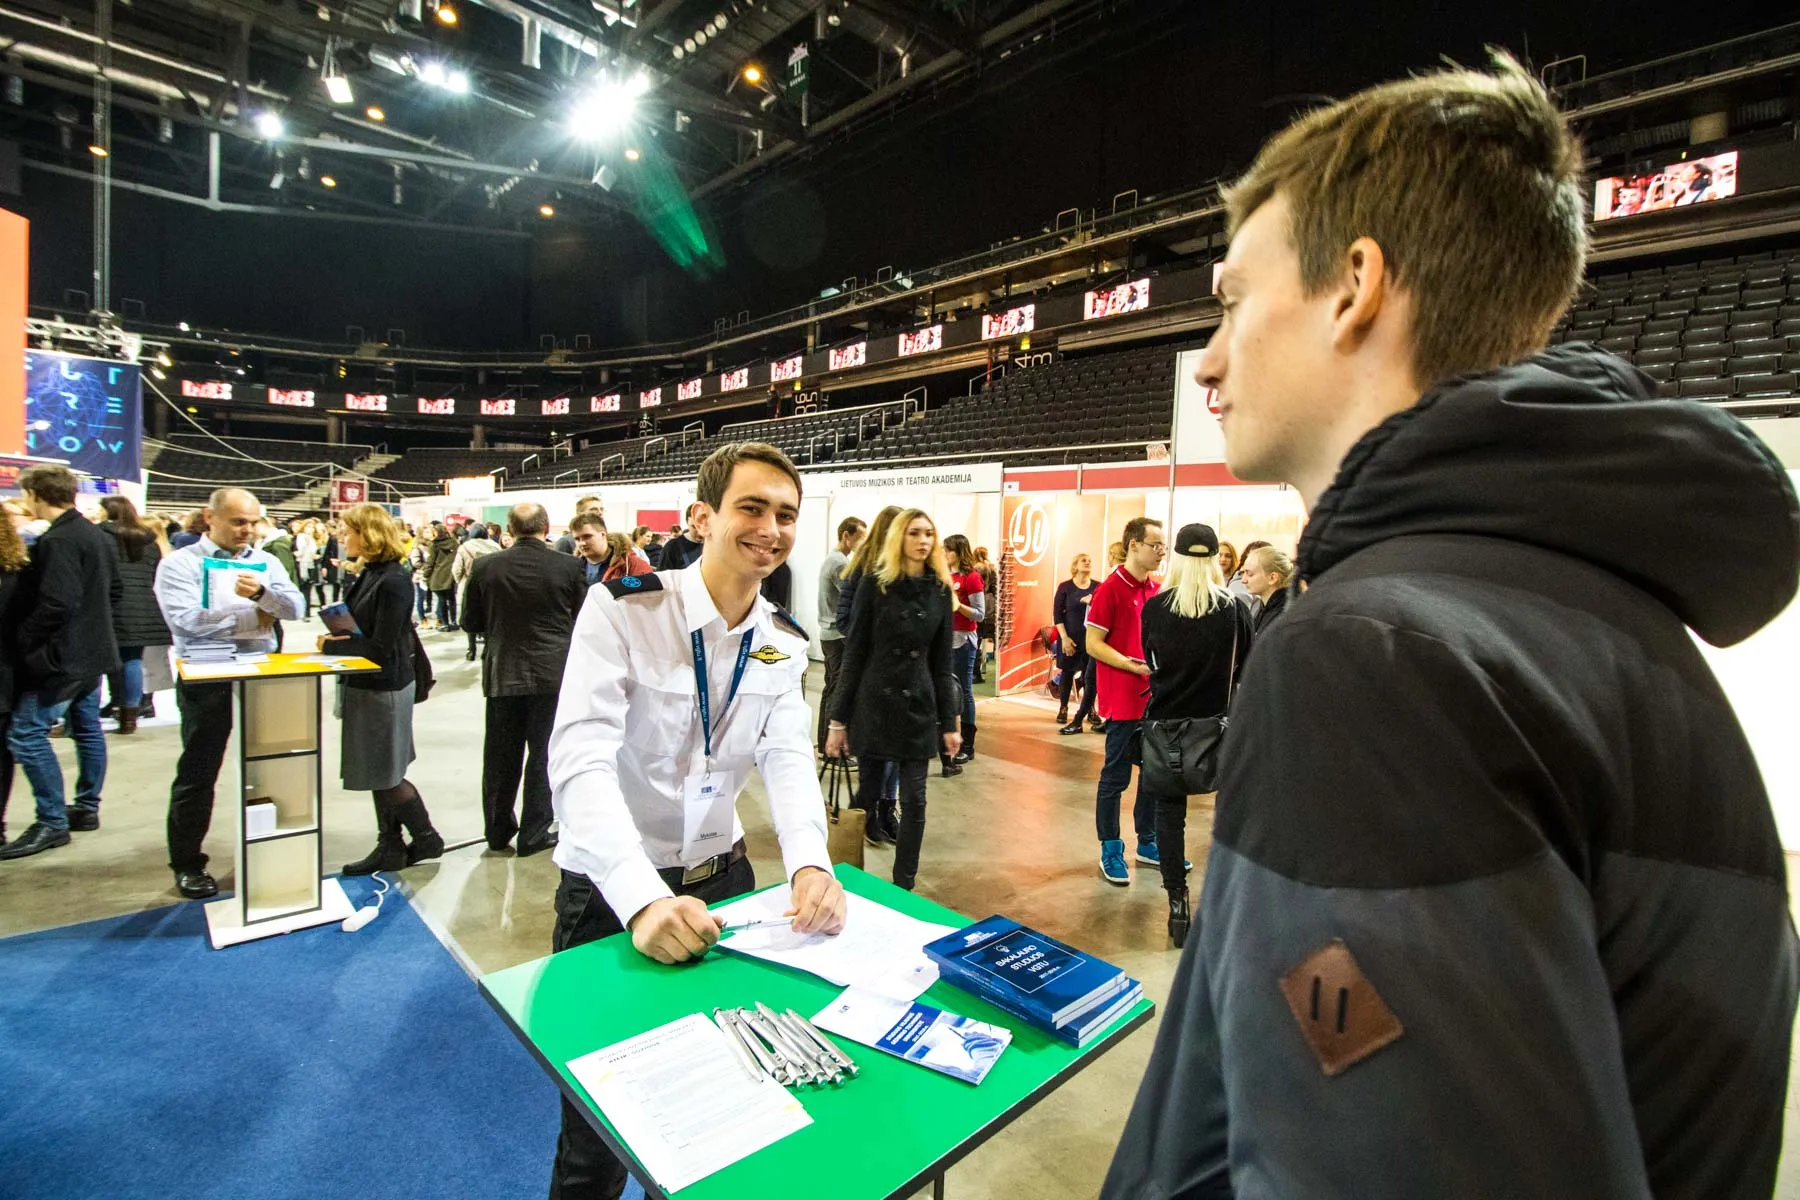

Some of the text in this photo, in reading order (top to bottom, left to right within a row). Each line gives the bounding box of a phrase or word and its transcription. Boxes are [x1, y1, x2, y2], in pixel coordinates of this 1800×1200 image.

[840, 473, 972, 488] LIETUVOS MUZIKOS IR TEATRO AKADEMIJA
[995, 945, 1037, 967] BAKALAURO
[1010, 951, 1045, 971] STUDIJOS
[1027, 960, 1050, 973] VGTU
